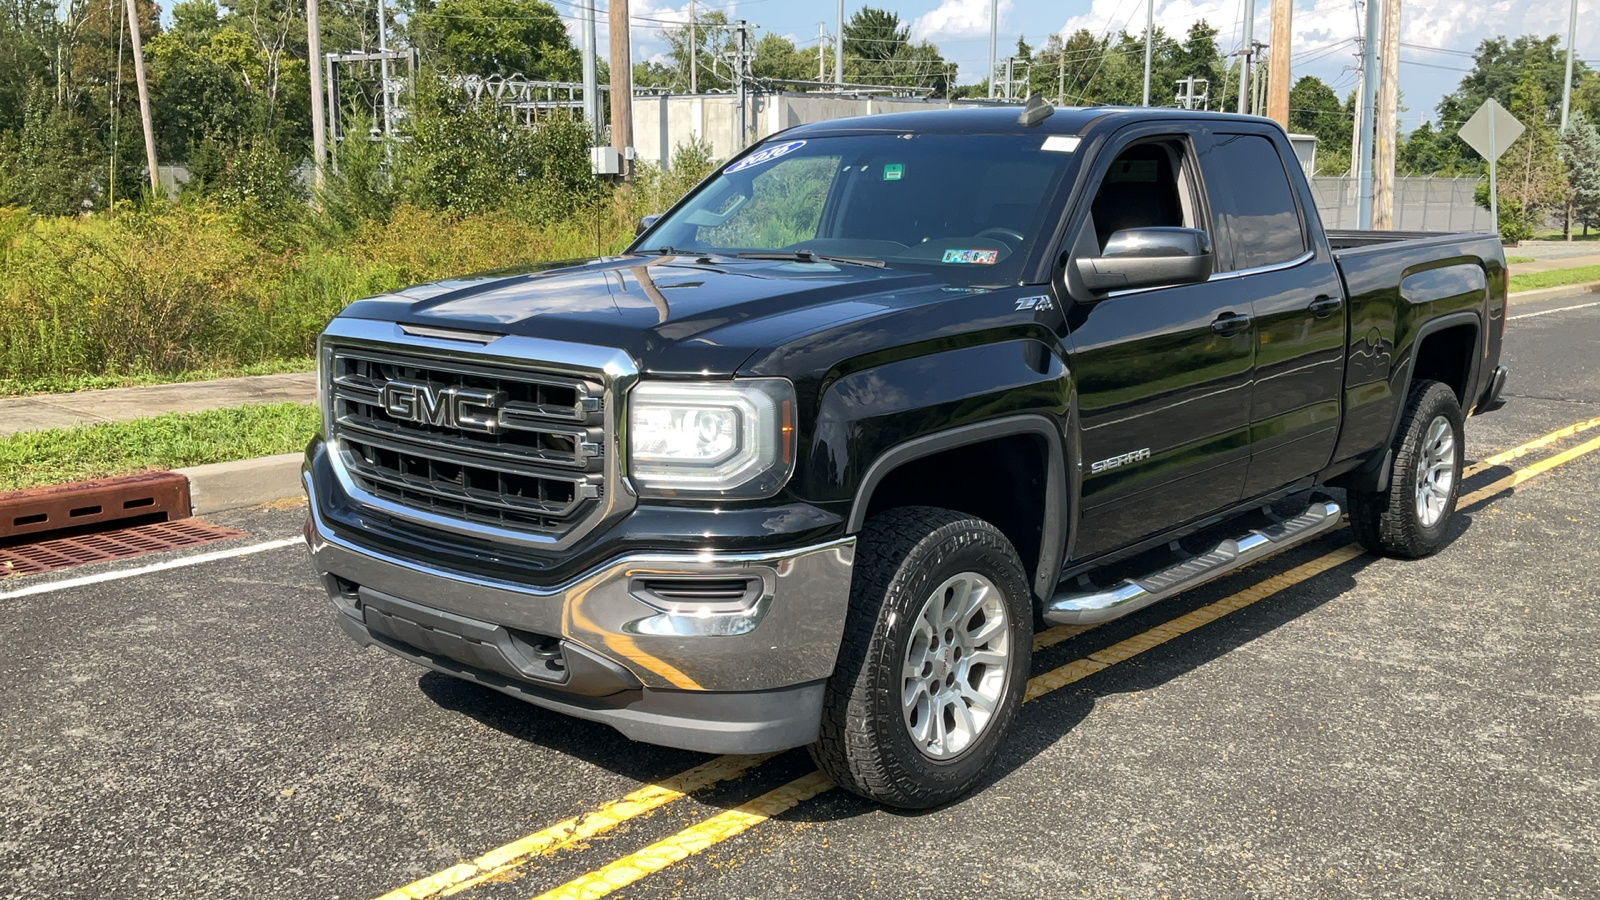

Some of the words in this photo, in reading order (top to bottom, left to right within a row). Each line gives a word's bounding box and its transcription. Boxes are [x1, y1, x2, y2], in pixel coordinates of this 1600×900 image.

[384, 380, 494, 434] GMC
[1091, 447, 1150, 474] SIERRA
[941, 649, 949, 676] GMC
